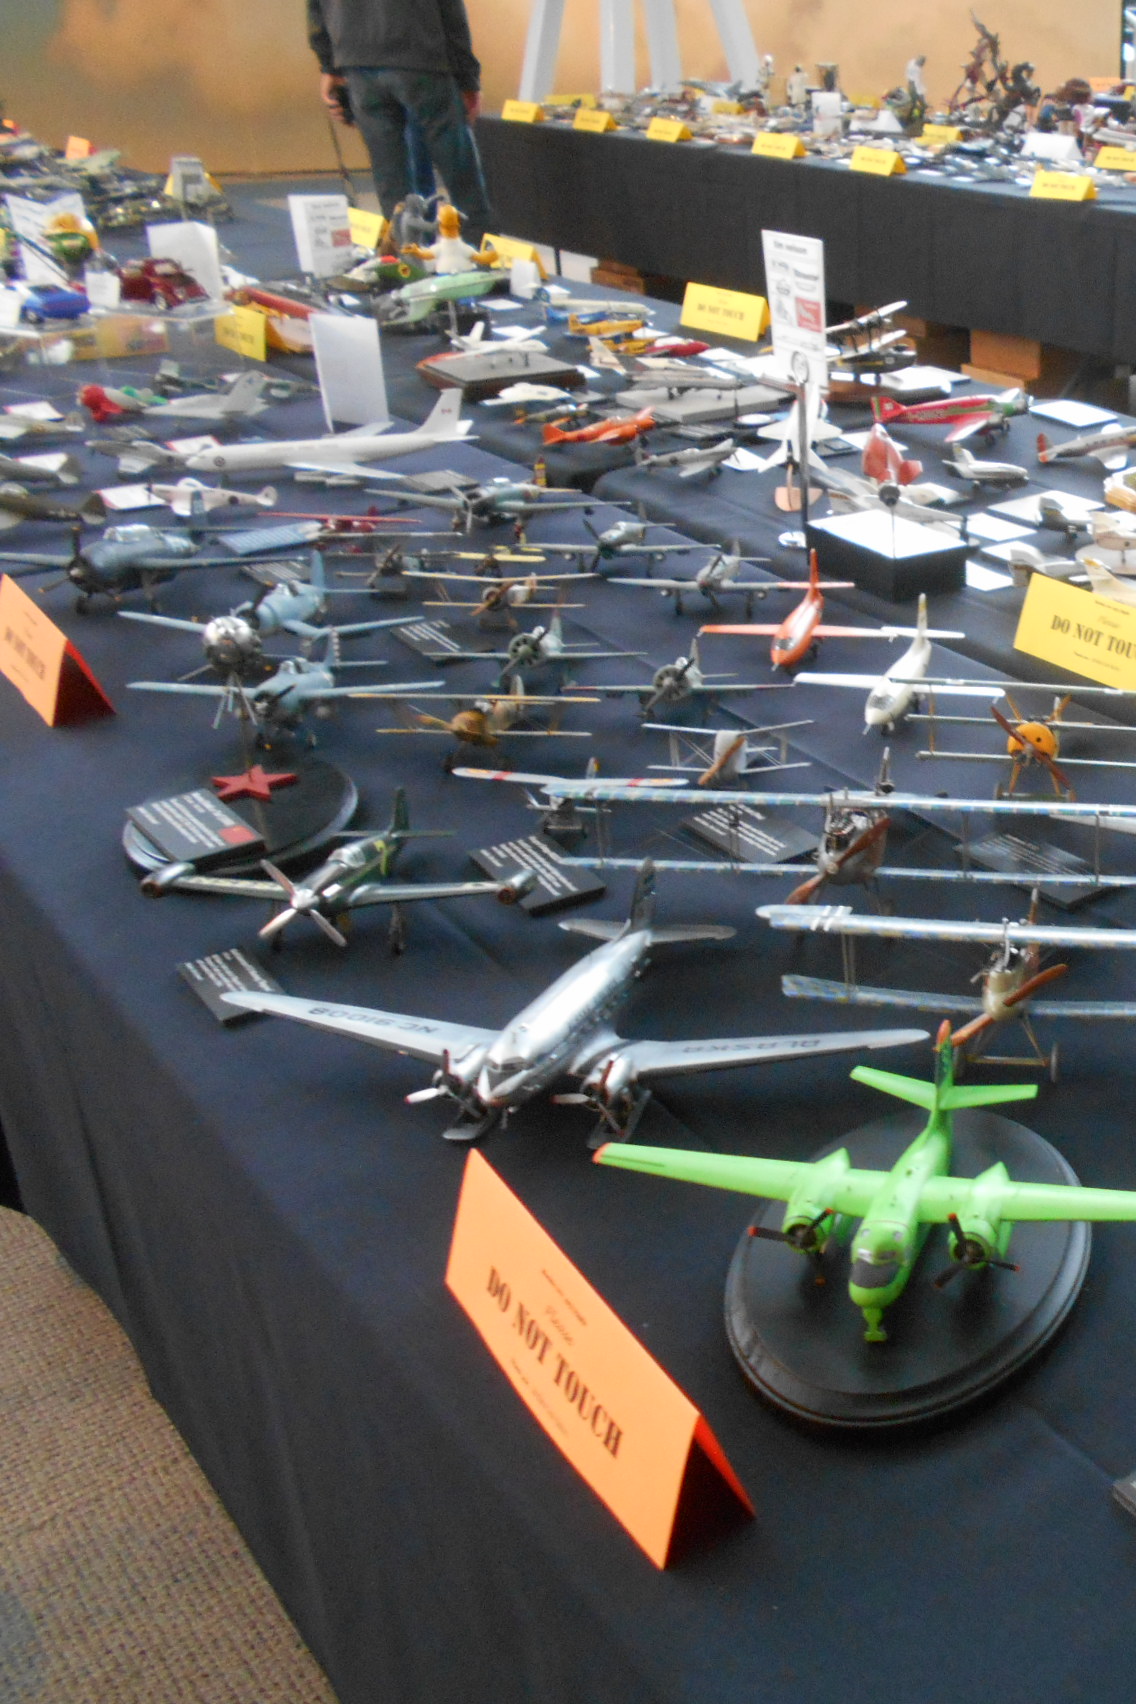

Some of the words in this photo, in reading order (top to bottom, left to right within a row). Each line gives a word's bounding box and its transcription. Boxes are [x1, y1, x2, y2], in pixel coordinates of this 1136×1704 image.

[1050, 614, 1070, 634] DO
[1073, 623, 1104, 647] NOT
[487, 1265, 511, 1313] DO
[512, 1300, 552, 1365] NOT
[554, 1352, 623, 1459] TOUCH
